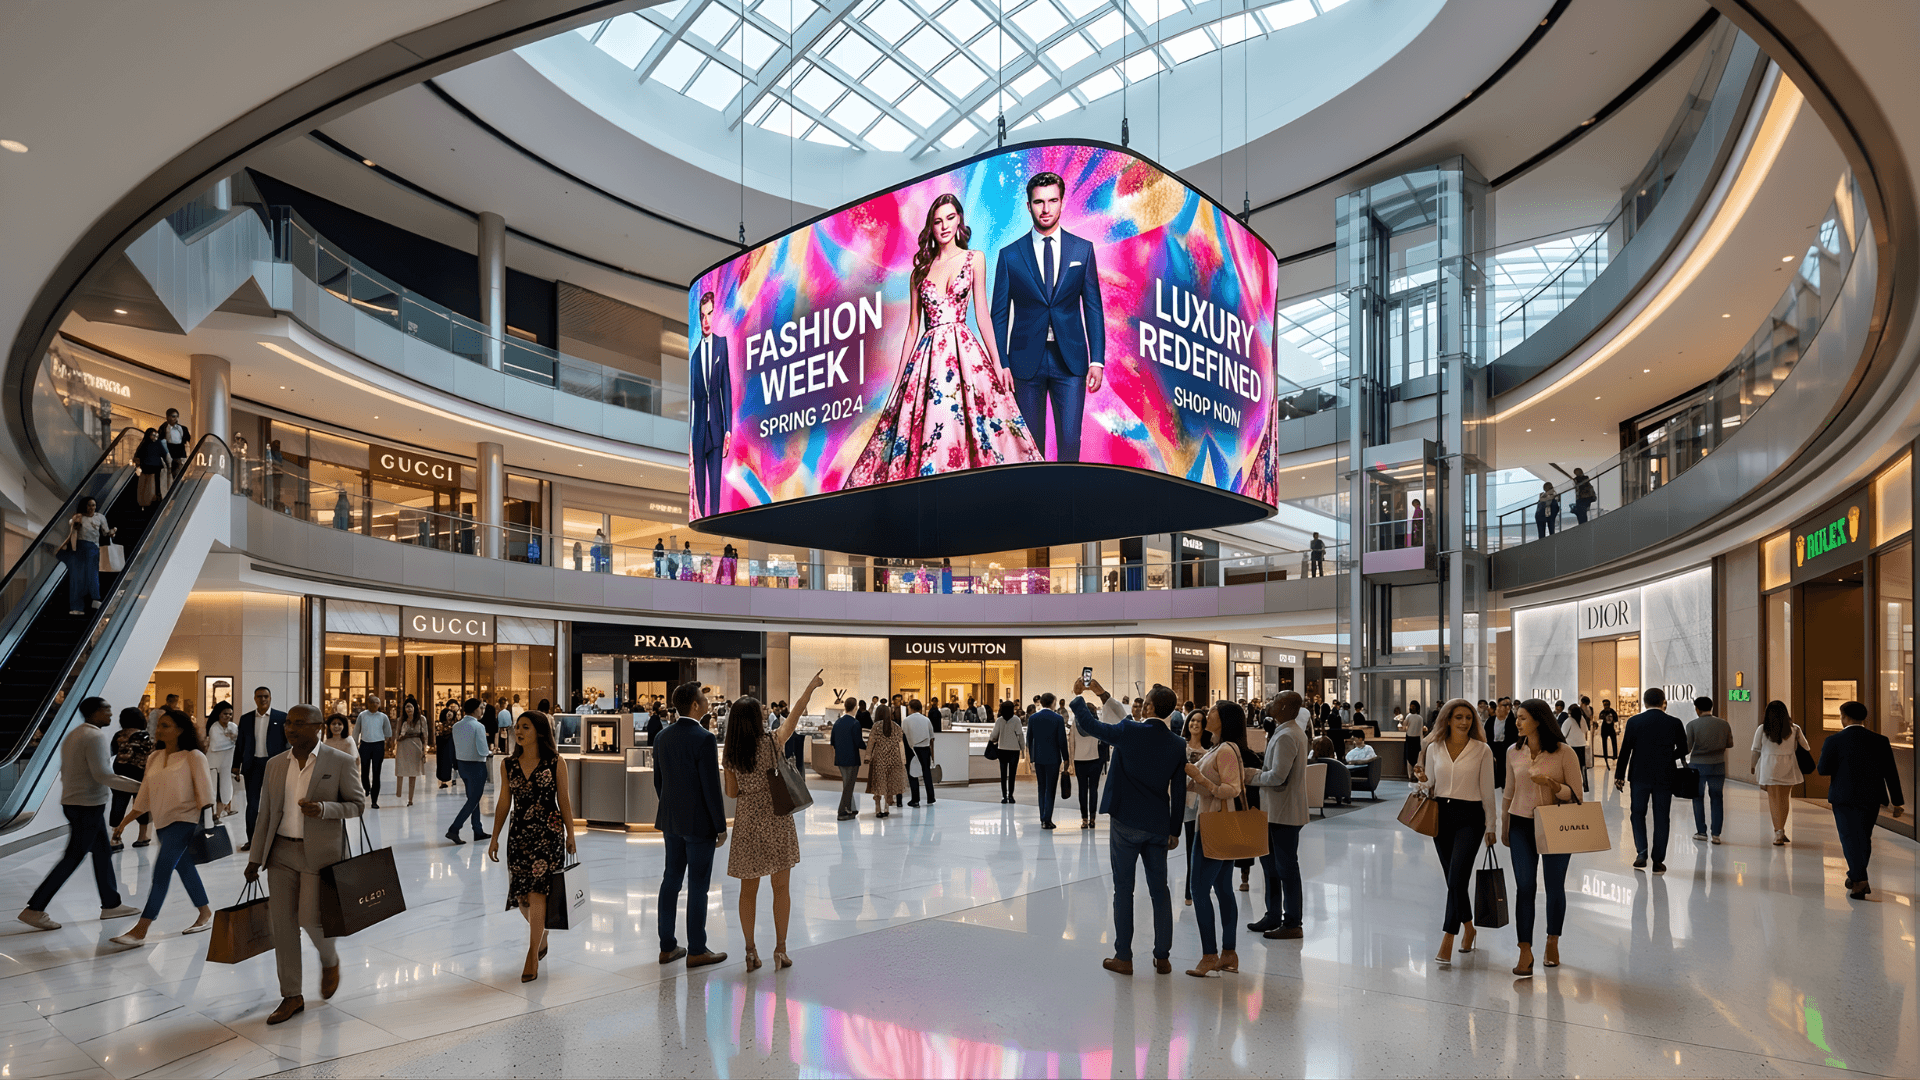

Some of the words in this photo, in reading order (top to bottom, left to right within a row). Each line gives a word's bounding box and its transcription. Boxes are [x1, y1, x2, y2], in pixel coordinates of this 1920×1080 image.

[746, 291, 882, 371] FASHION
[1156, 278, 1255, 359] LUXURY
[760, 346, 850, 406] WEEK
[1139, 320, 1262, 403] REDEFINED
[1174, 386, 1211, 416] SHOP
[759, 407, 817, 438] SPRING
[821, 395, 864, 424] 2024
[381, 454, 453, 481] GUCCI
[412, 614, 487, 636] GUCCI
[1588, 600, 1629, 629] DIOR
[634, 634, 693, 649] PRADA
[905, 642, 946, 654] LOUIS
[948, 642, 1006, 654] VUITTON
